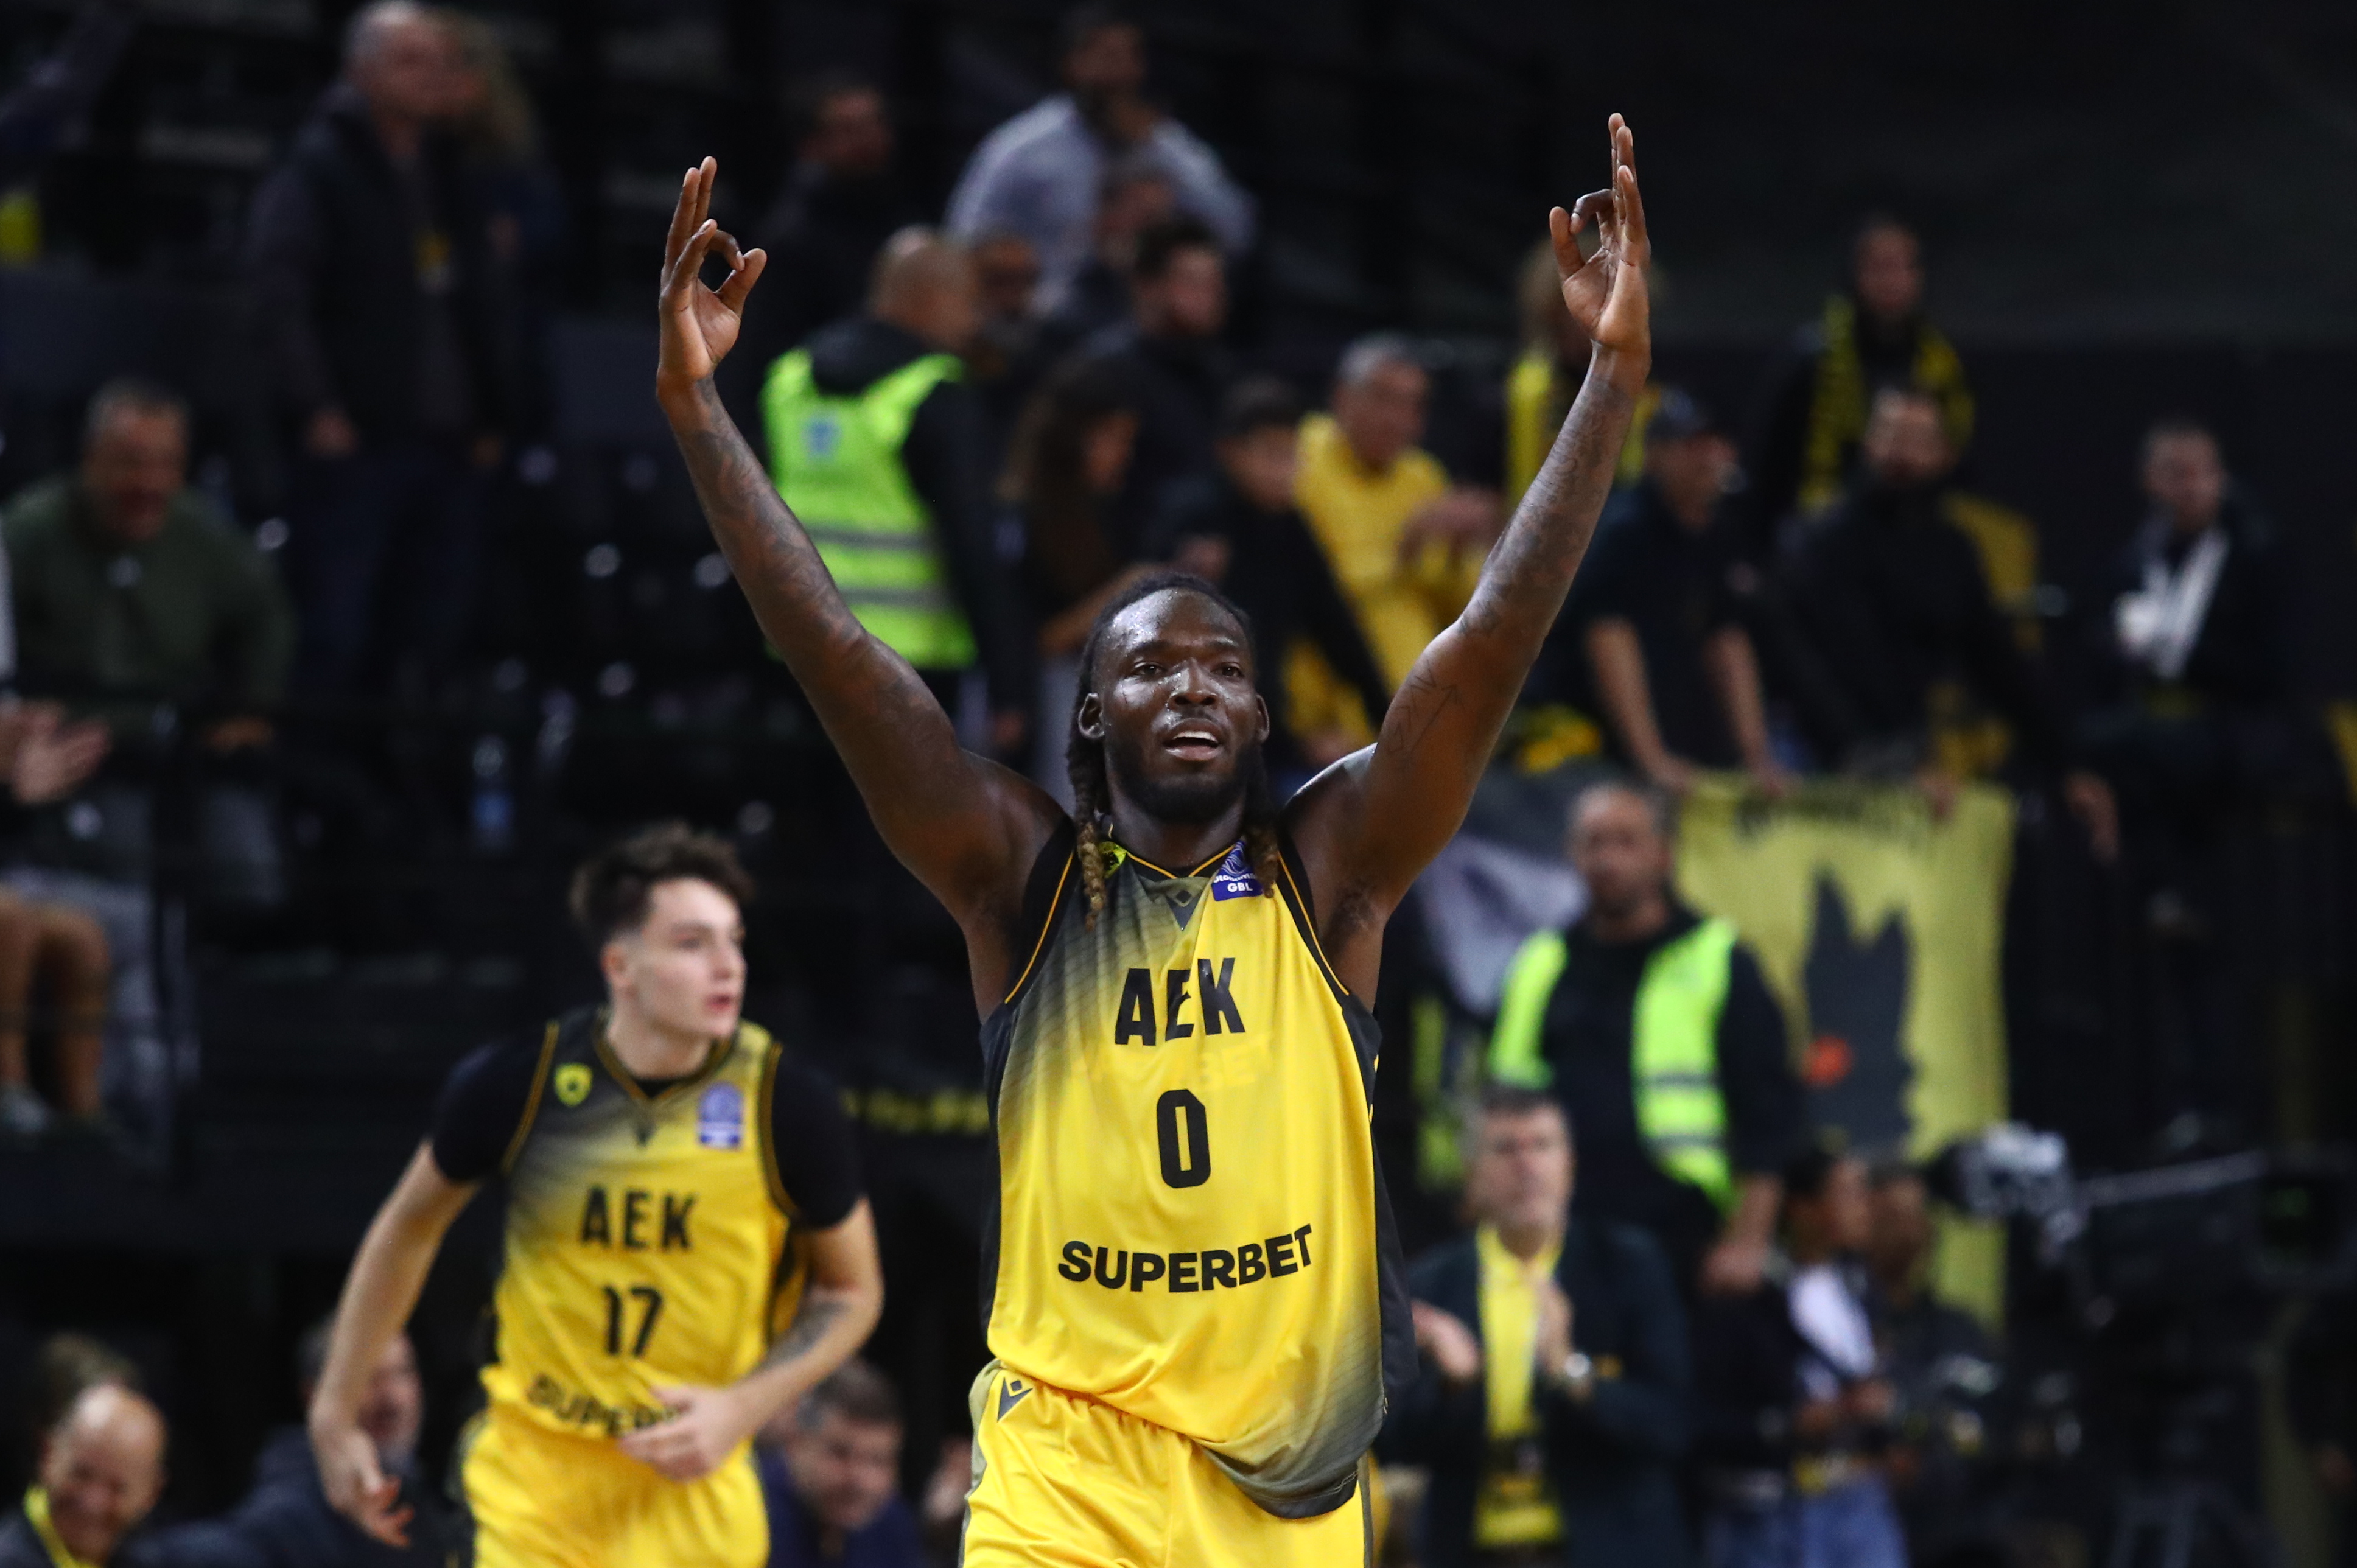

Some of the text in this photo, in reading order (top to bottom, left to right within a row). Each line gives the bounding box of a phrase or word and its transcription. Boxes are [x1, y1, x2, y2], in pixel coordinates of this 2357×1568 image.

[1227, 882, 1253, 892] GBL
[1115, 957, 1245, 1046] AEK
[1157, 1088, 1211, 1189] 0
[580, 1183, 696, 1250] AEK
[1058, 1224, 1312, 1293] SUPERBET
[603, 1286, 664, 1357] 17
